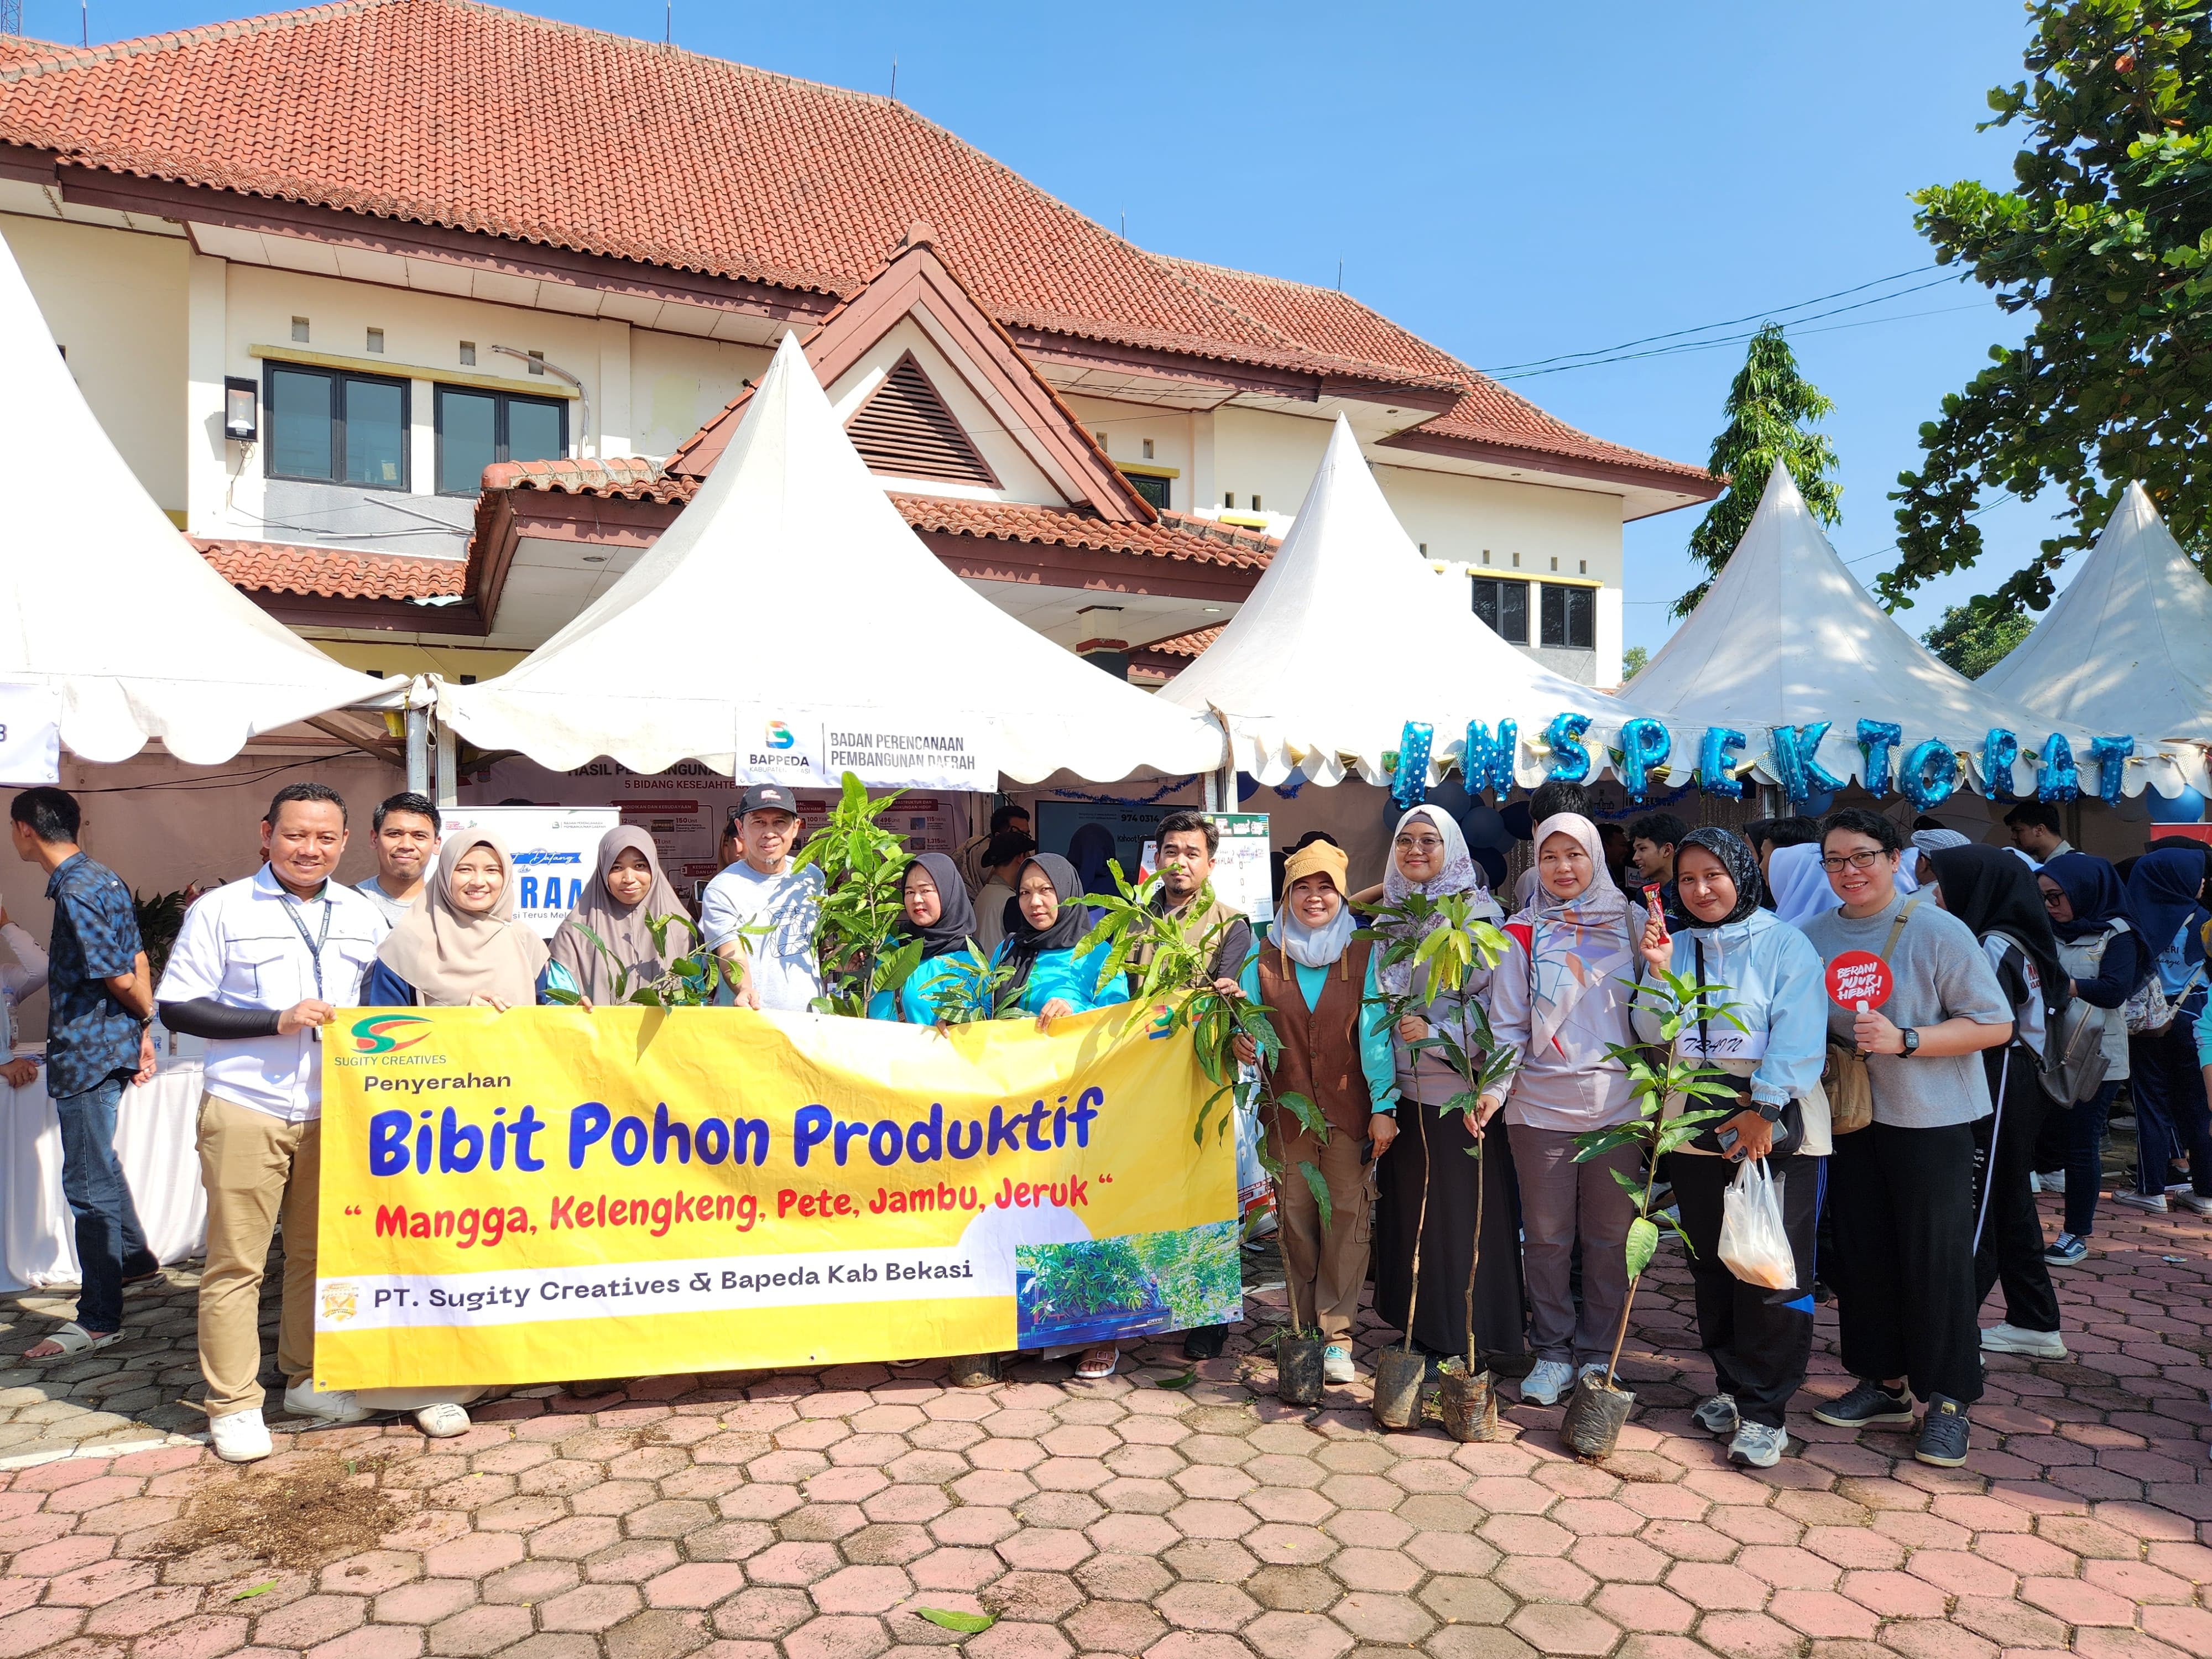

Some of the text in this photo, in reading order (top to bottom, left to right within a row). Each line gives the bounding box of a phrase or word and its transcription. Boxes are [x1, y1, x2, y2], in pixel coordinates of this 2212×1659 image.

[831, 733, 964, 752] BADAN PERENCANAAN
[749, 754, 810, 767] BAPPEDA
[831, 751, 975, 770] PEMBANGUNAN DAERAH
[624, 780, 631, 789] 5
[634, 780, 674, 789] BIDANG
[528, 848, 576, 866] Datang
[1837, 962, 1877, 979] BERANI
[1837, 974, 1876, 991] JUJUR
[335, 1055, 447, 1066] SUGITY CREATIVES
[364, 1072, 511, 1094] Penyerahan
[369, 1087, 1104, 1176] Bibit Pohon Produktif
[375, 1204, 538, 1249] Mangga,
[550, 1190, 766, 1237] Kelengkeng,
[778, 1188, 860, 1218] Pete,
[869, 1181, 986, 1214] Jambu,
[995, 1173, 1088, 1209] Jeruk
[375, 1260, 973, 1311] PT. Sugity Creatives & Bapeda Kab Bekasi
